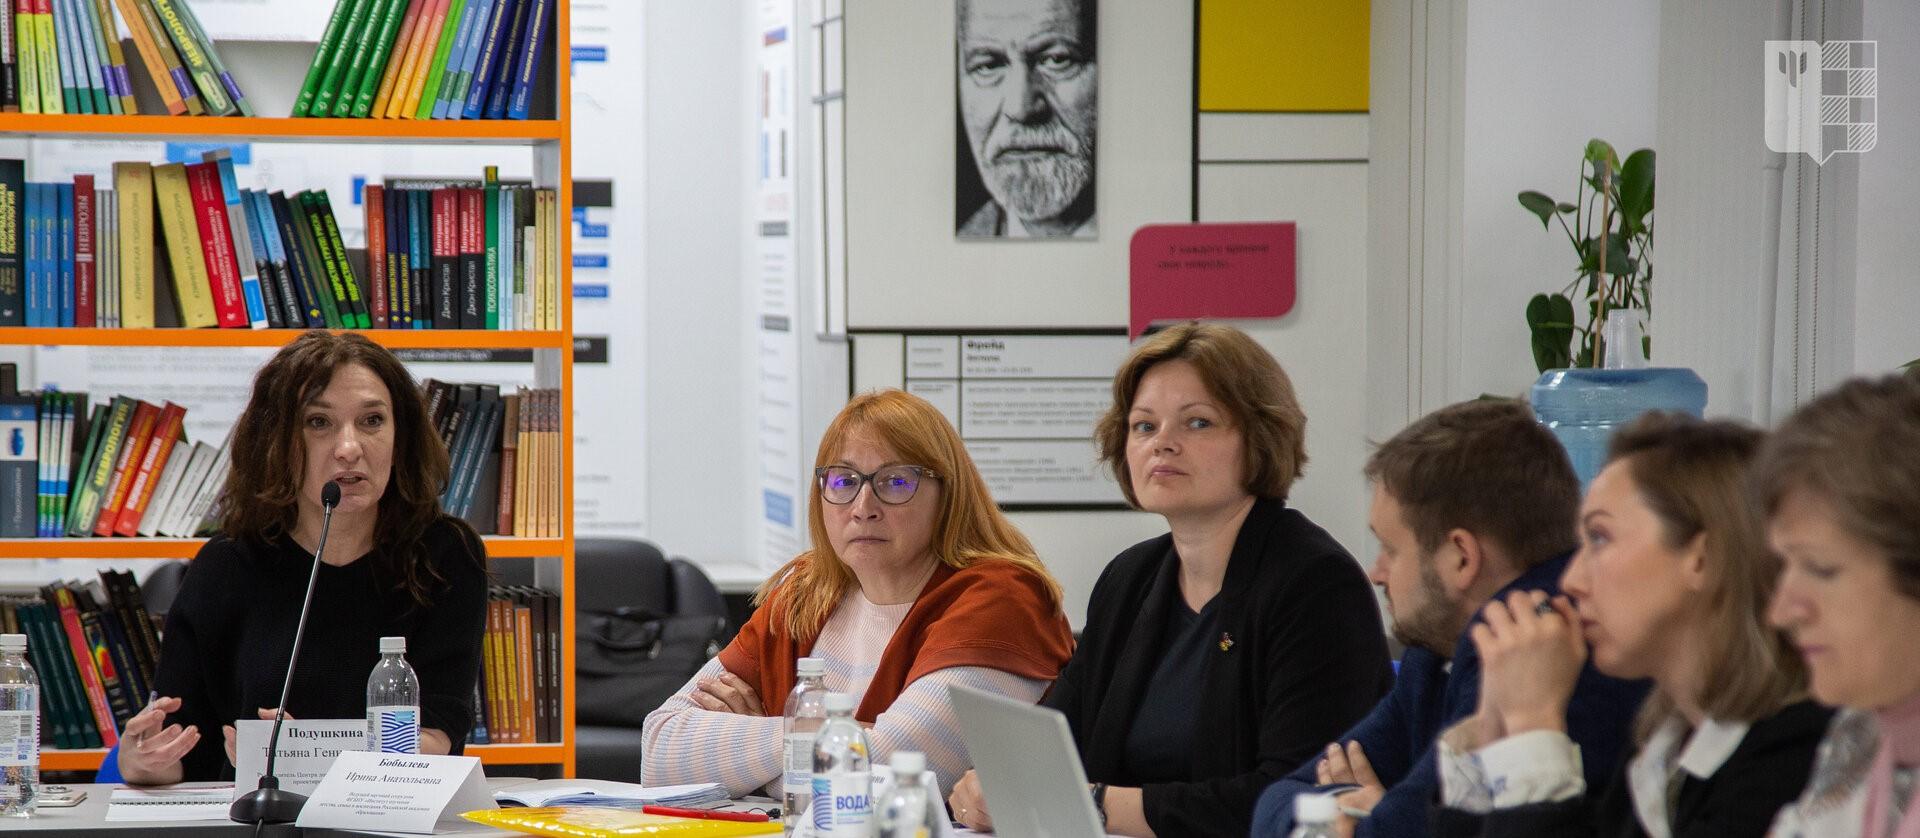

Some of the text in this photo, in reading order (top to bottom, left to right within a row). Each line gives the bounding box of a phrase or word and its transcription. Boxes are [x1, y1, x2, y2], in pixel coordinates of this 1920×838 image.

[7, 191, 16, 253] ПСИХОЛОГИЯ
[77, 195, 89, 252] НЕВРОЗЫ
[442, 263, 450, 318] Джон Кристал
[467, 260, 475, 315] Джон Кристал
[487, 247, 496, 312] ПСИХОСОМАТИКА
[93, 402, 128, 487] НЕВРОЛОГИЯ
[262, 747, 310, 758] Ттьяна
[289, 728, 363, 742] Подушкина
[345, 771, 442, 785] Ирина Анатольевна
[378, 758, 430, 769] Бобылева
[836, 794, 870, 811] ВОДА
